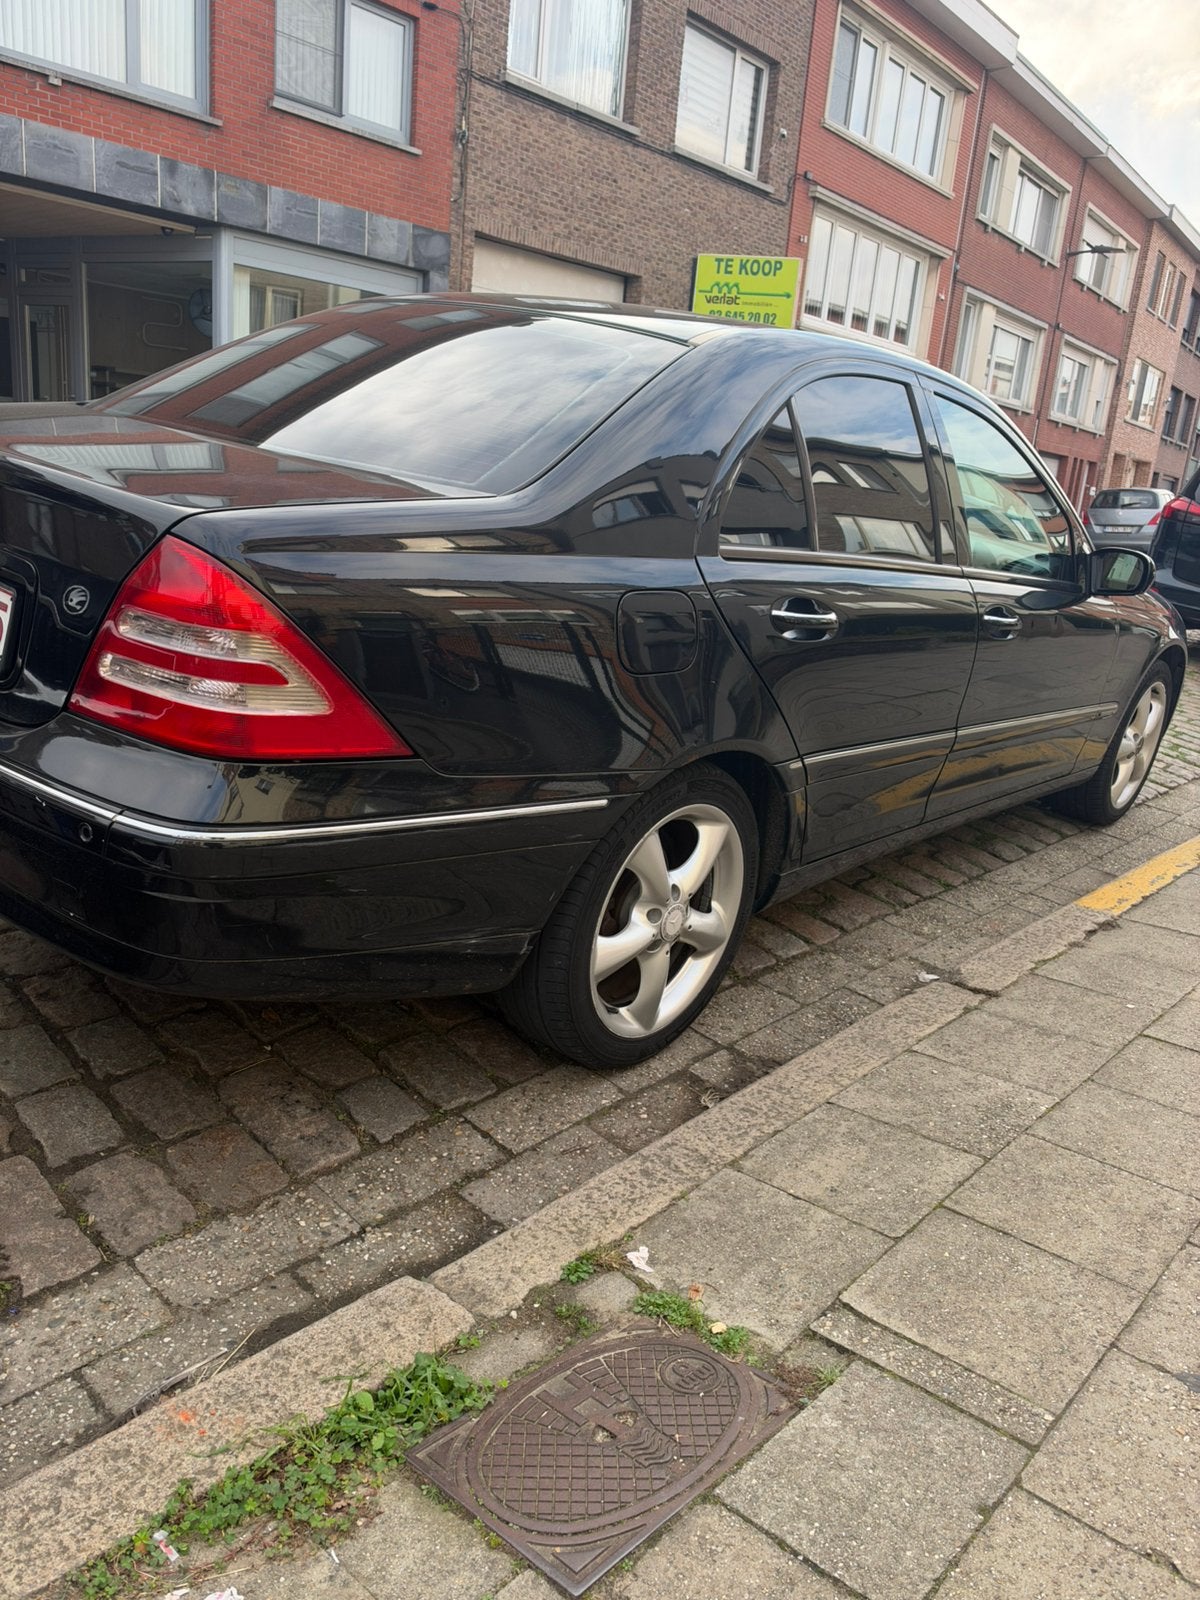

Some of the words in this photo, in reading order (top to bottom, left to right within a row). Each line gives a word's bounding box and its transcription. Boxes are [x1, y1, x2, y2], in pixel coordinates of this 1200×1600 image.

[715, 257, 734, 274] TE
[738, 258, 783, 277] KOOP
[763, 312, 777, 325] 02
